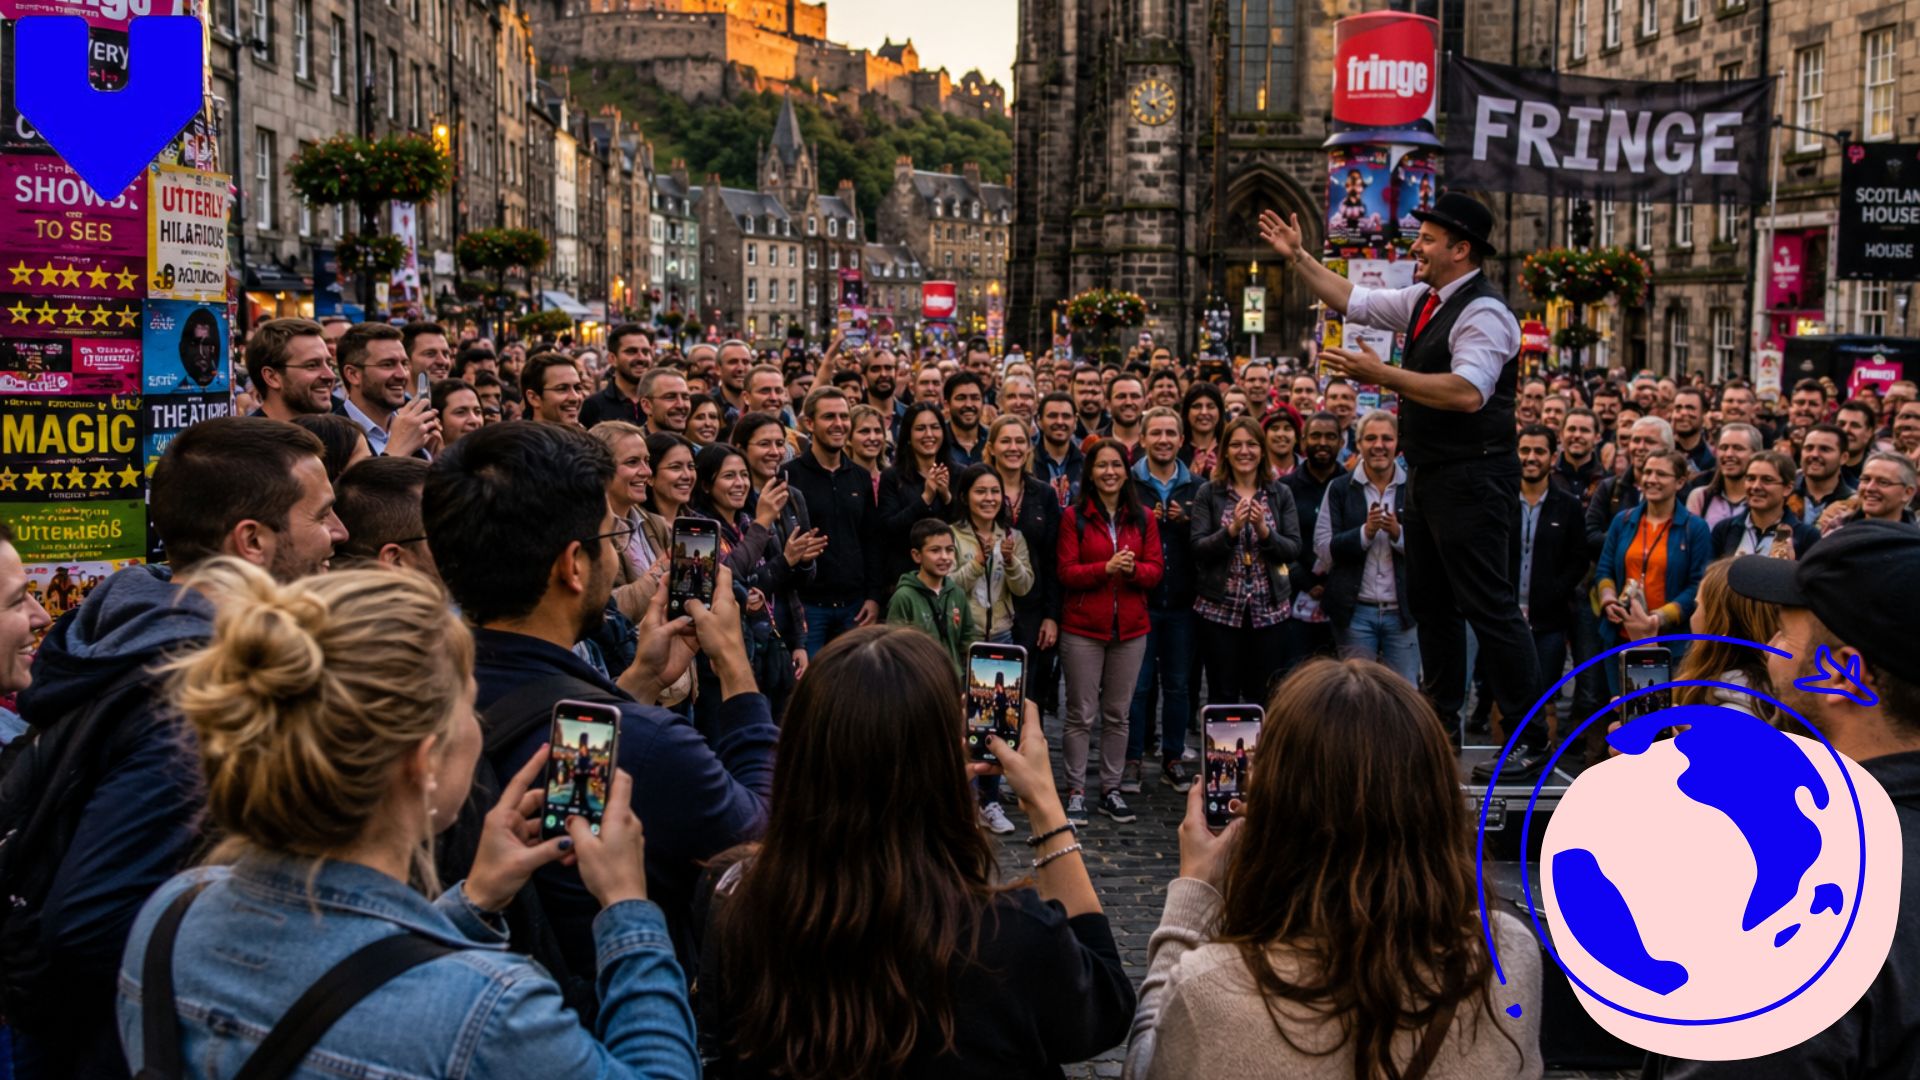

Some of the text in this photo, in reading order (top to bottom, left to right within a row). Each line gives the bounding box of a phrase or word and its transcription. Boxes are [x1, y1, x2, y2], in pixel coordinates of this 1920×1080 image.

[1347, 53, 1428, 97] fringe
[1473, 94, 1743, 175] FRINGE
[162, 184, 224, 219] UTTERLY
[1862, 206, 1920, 224] HOUSE
[35, 219, 112, 242] TO SES
[160, 219, 224, 249] HILARIOUS
[1864, 242, 1914, 258] HOUSE
[3, 412, 136, 454] MAGIC
